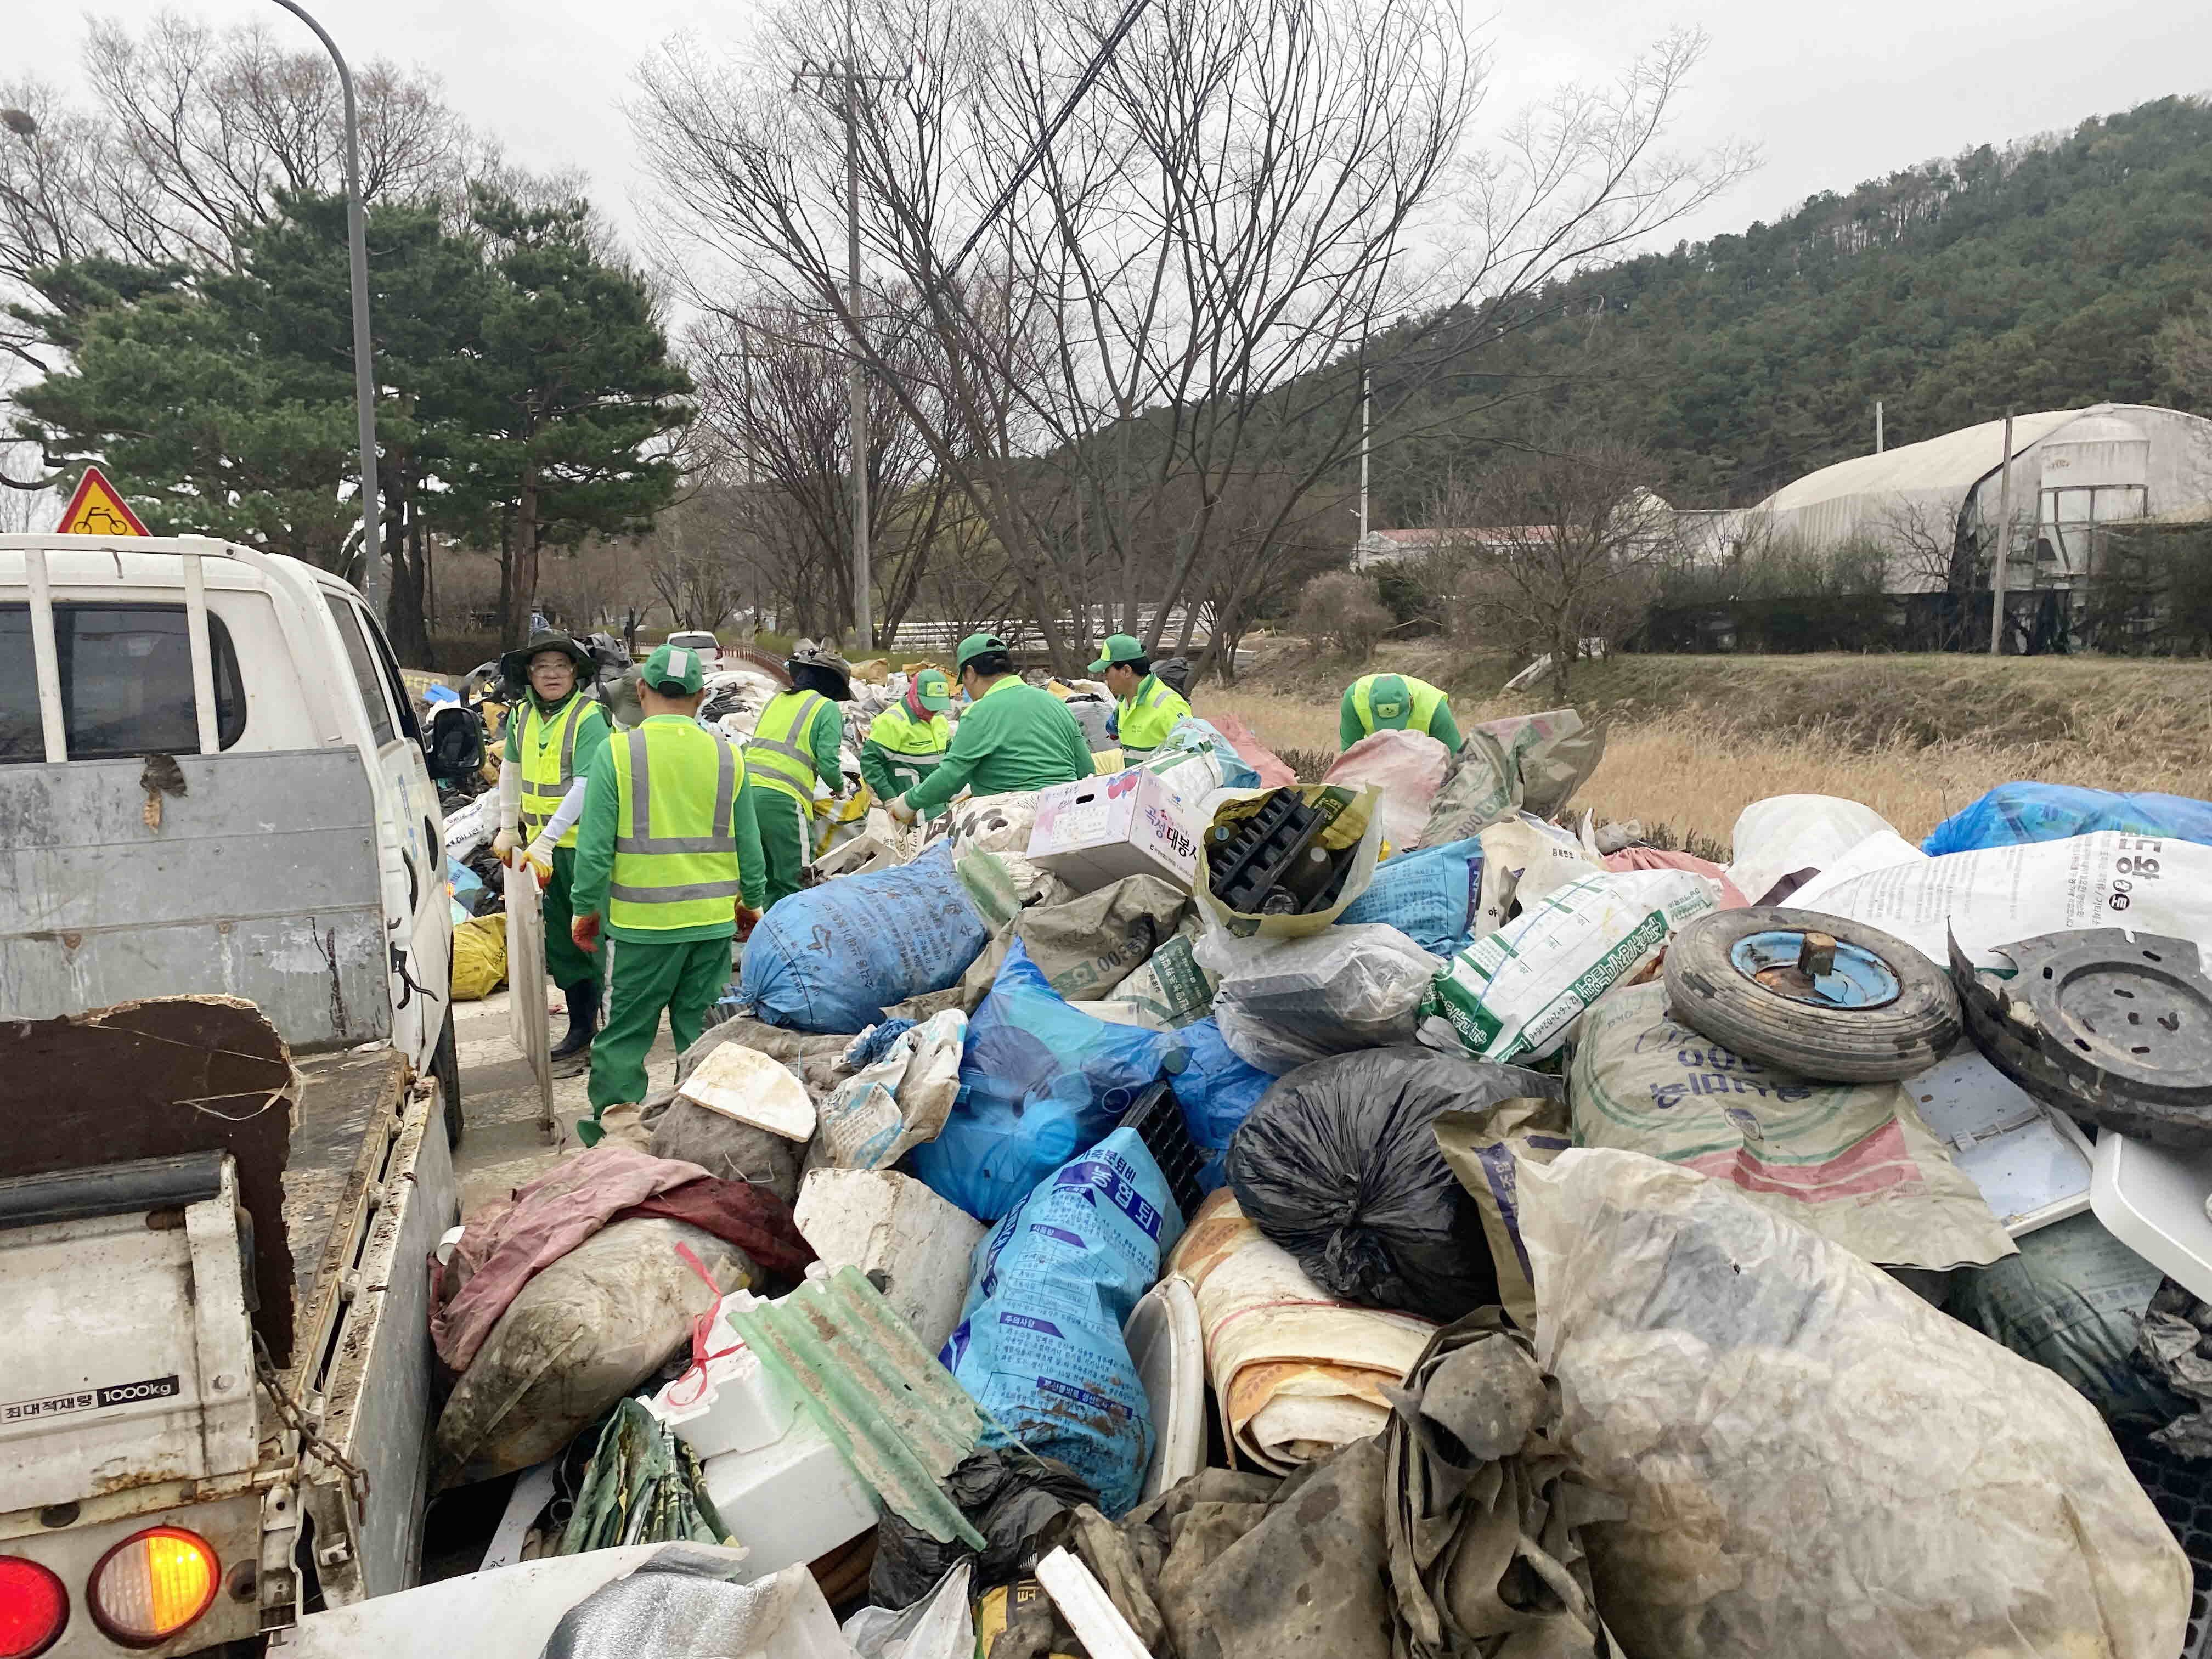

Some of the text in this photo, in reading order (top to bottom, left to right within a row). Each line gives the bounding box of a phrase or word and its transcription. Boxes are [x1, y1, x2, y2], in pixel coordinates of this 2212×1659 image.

[1004, 1313, 1035, 1329] 주의사항
[4, 1381, 172, 1419] 최대적재량 1000kg
